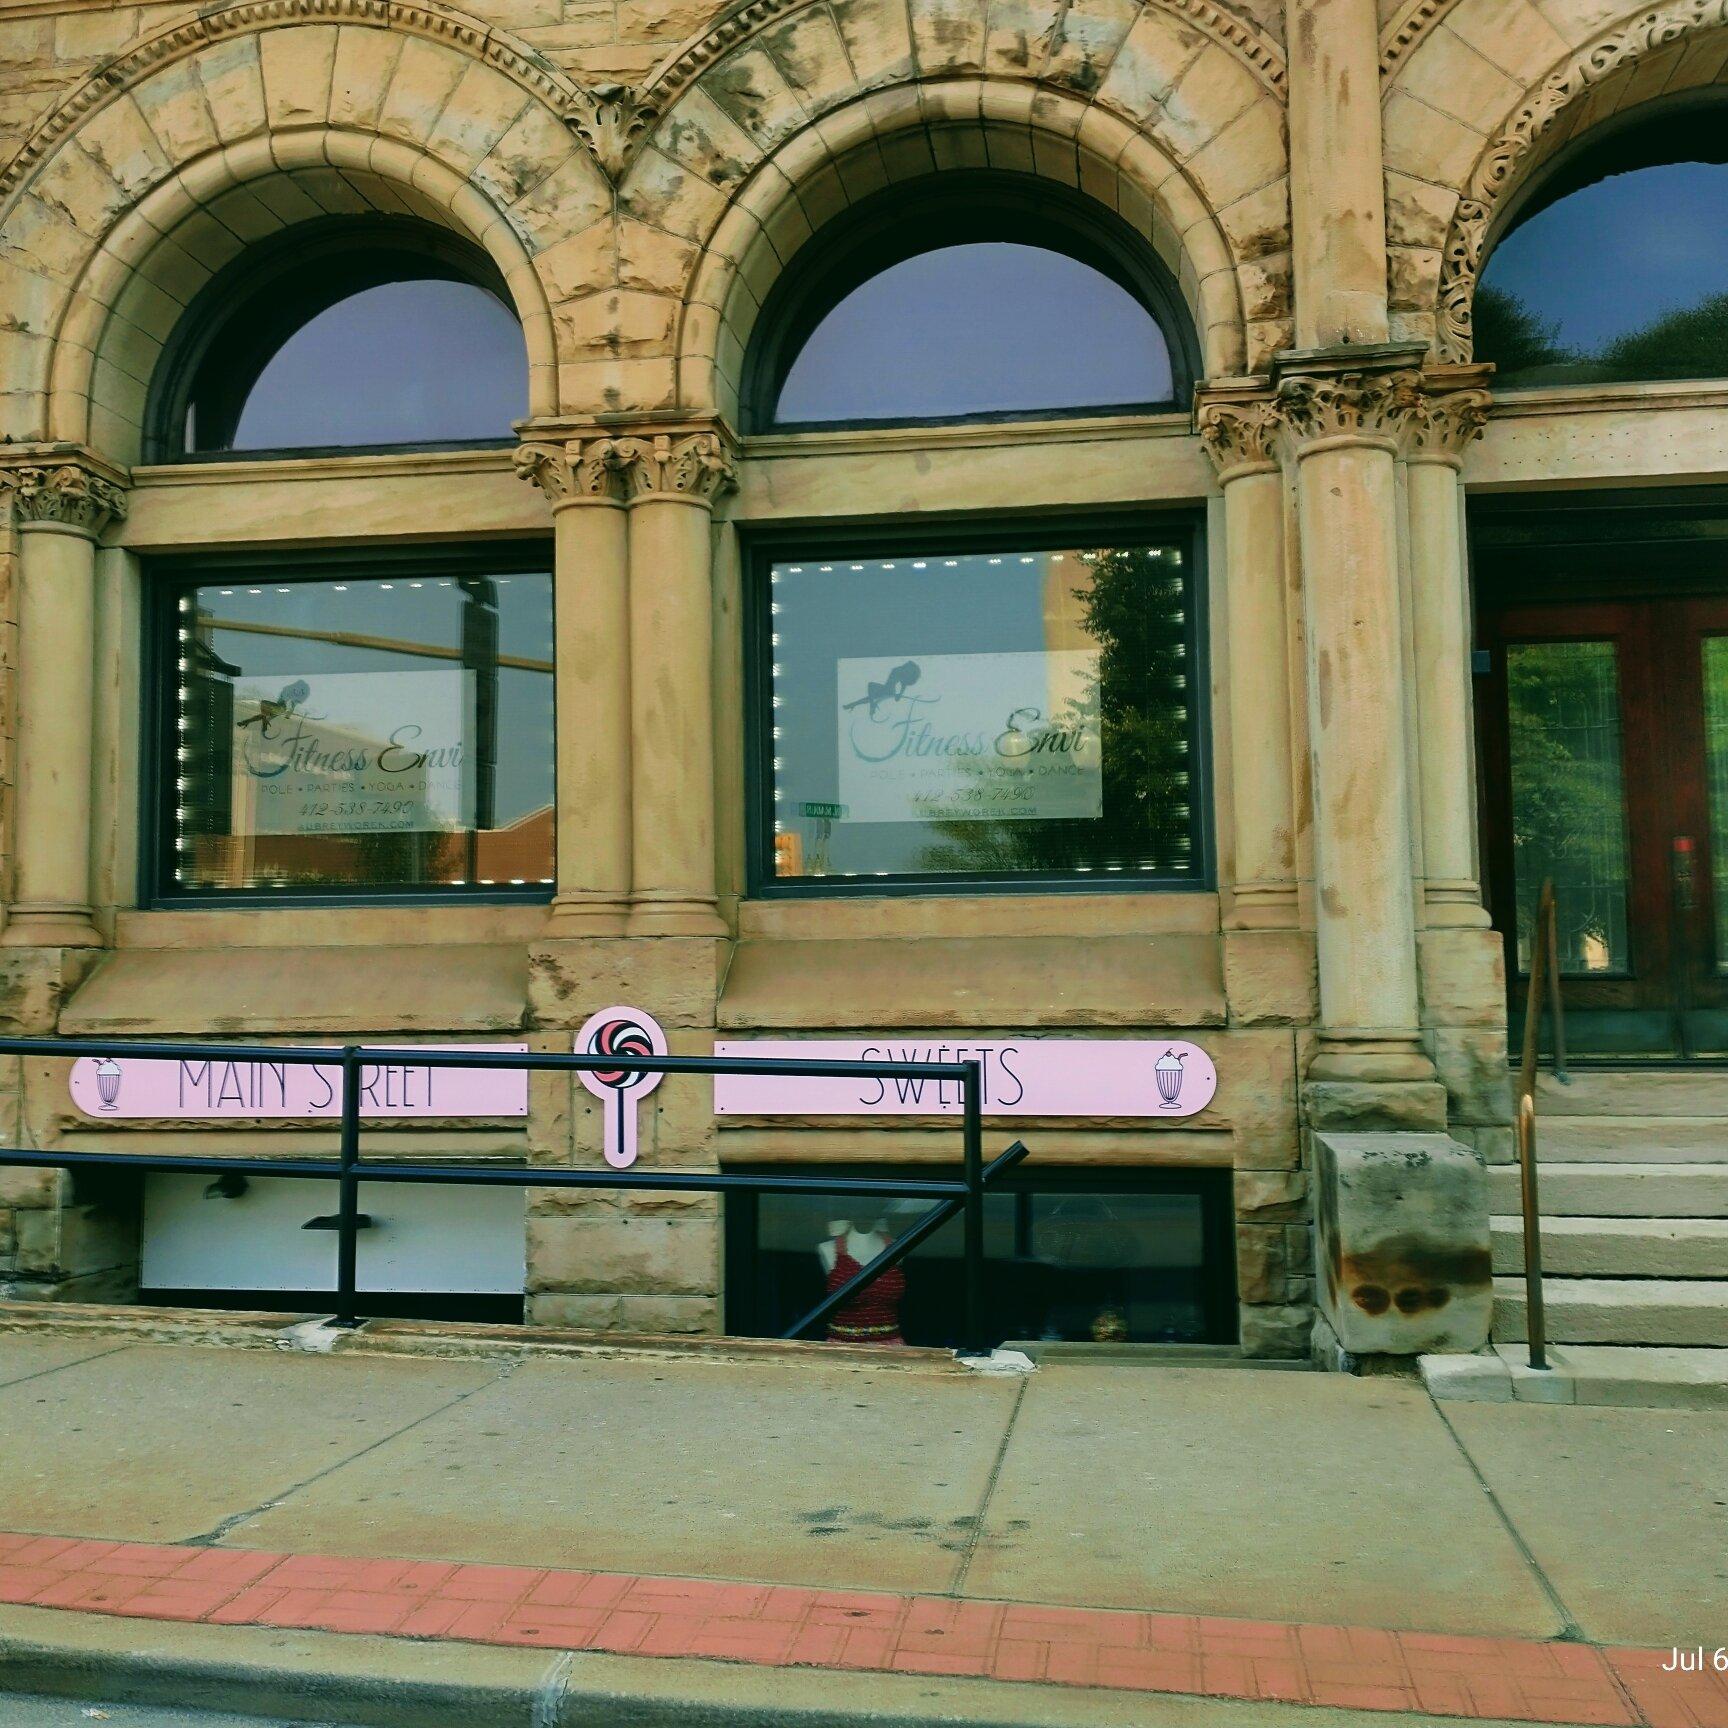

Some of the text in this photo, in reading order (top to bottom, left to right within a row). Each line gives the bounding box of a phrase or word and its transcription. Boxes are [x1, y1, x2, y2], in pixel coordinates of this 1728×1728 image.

[243, 713, 465, 778] Fitness Envi
[850, 695, 1088, 763] Fitness Envi
[261, 783, 293, 795] POLE
[306, 782, 354, 793] PARTIES
[368, 781, 404, 793] YOGA
[920, 767, 972, 778] PARTIES
[988, 766, 1024, 777] YOGA
[1039, 764, 1087, 776] DANCE
[178, 1059, 432, 1109] MAIN SREET
[859, 1047, 1024, 1106] SWEETS
